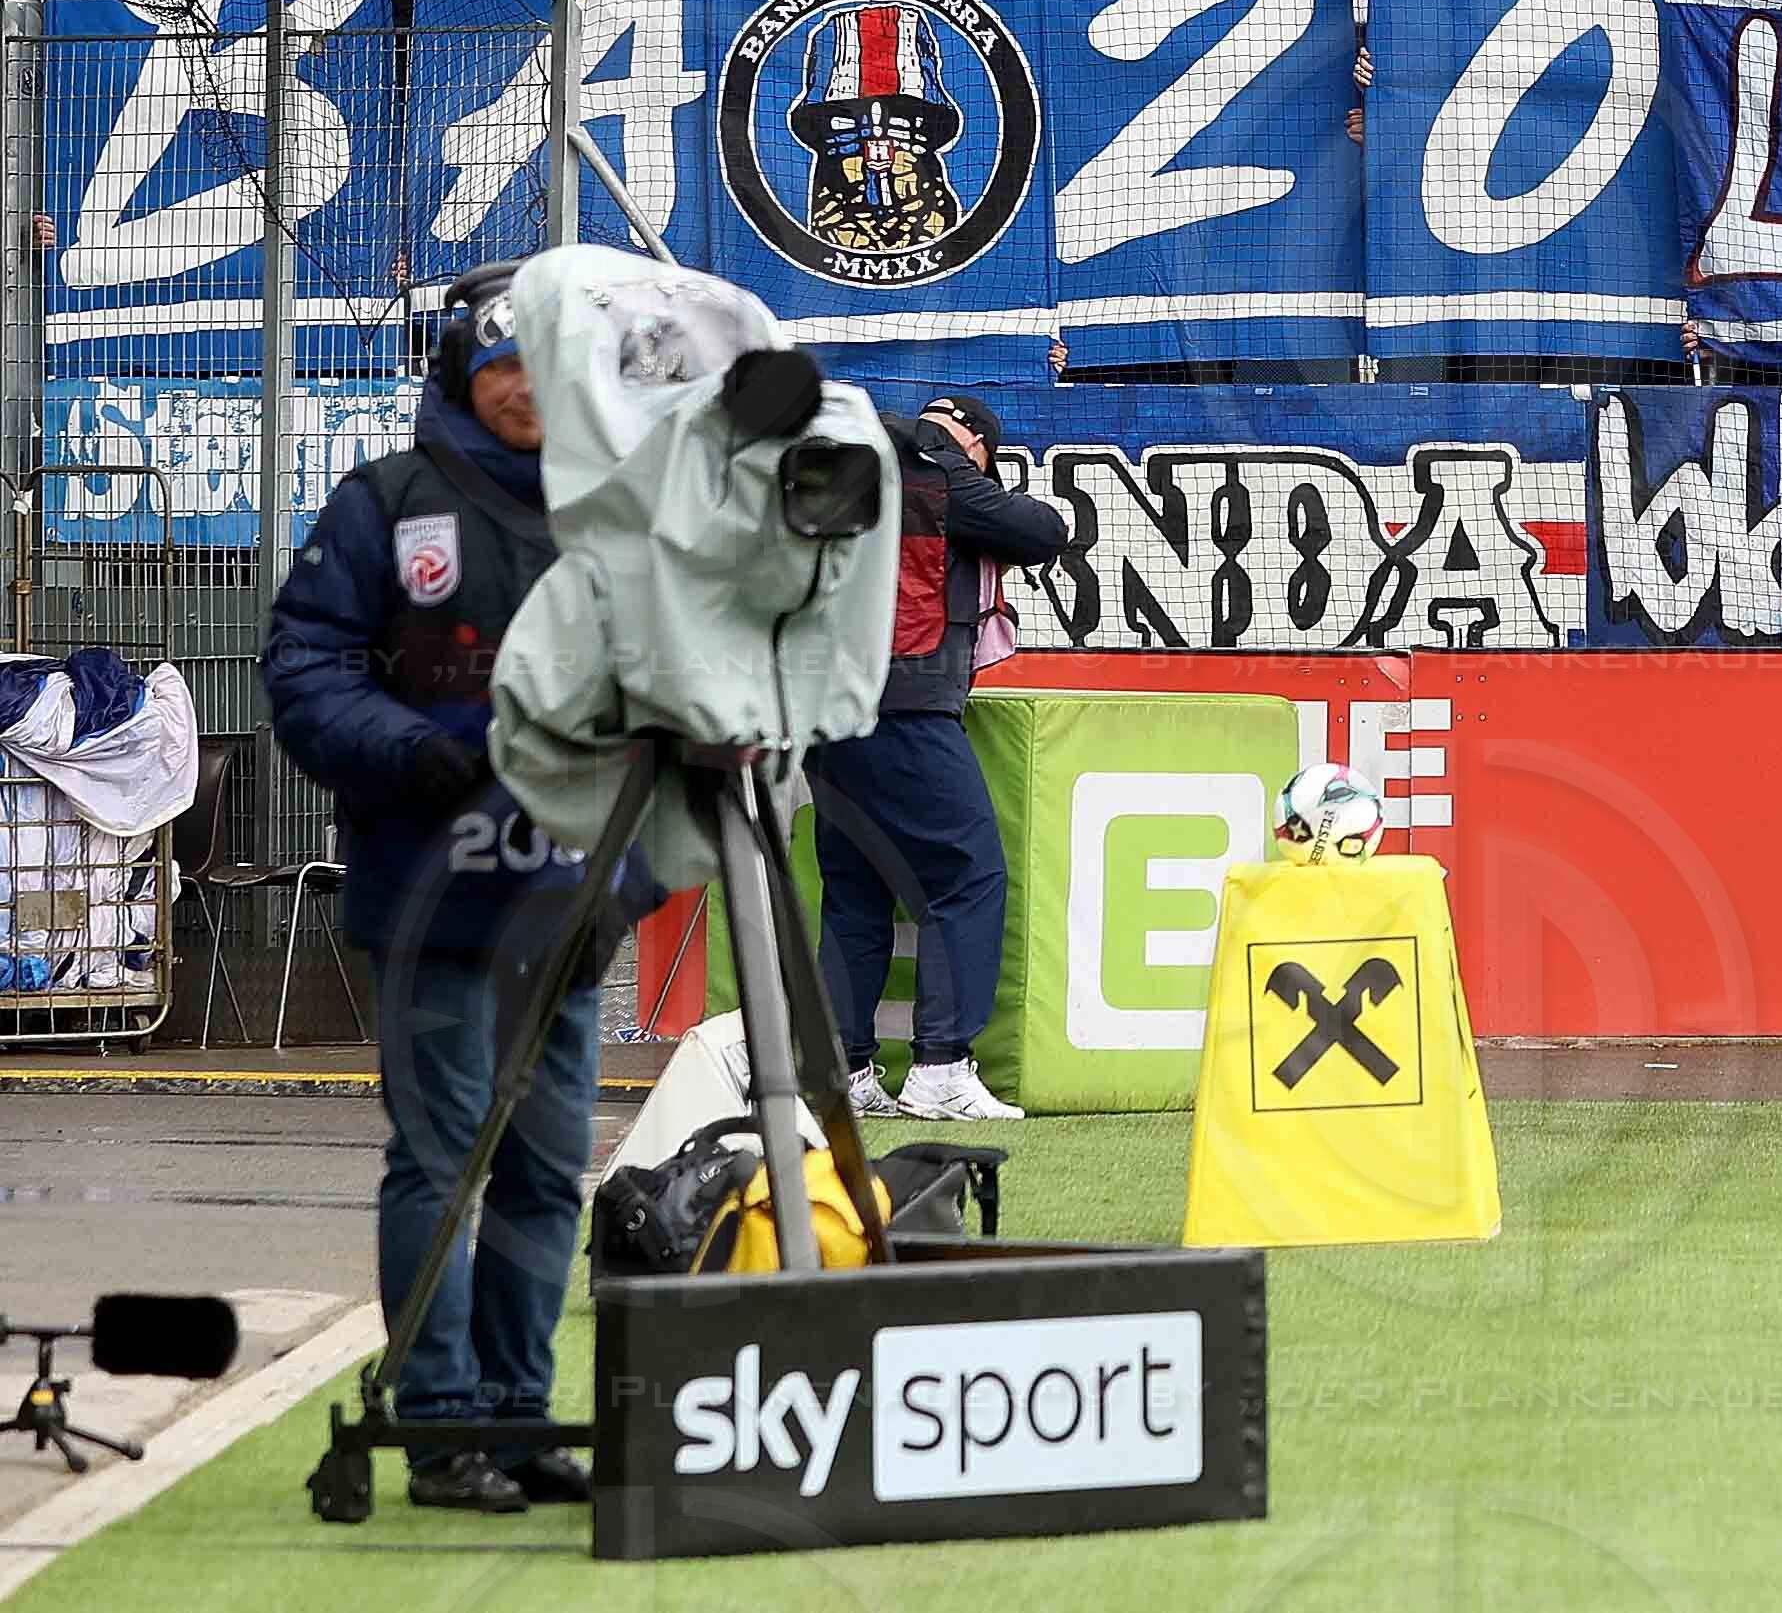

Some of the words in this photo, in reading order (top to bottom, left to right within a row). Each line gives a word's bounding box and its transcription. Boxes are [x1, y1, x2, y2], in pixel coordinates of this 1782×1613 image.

[1000, 442, 1560, 648] NDA
[672, 1343, 862, 1498] sky
[901, 1347, 1175, 1474] sport
